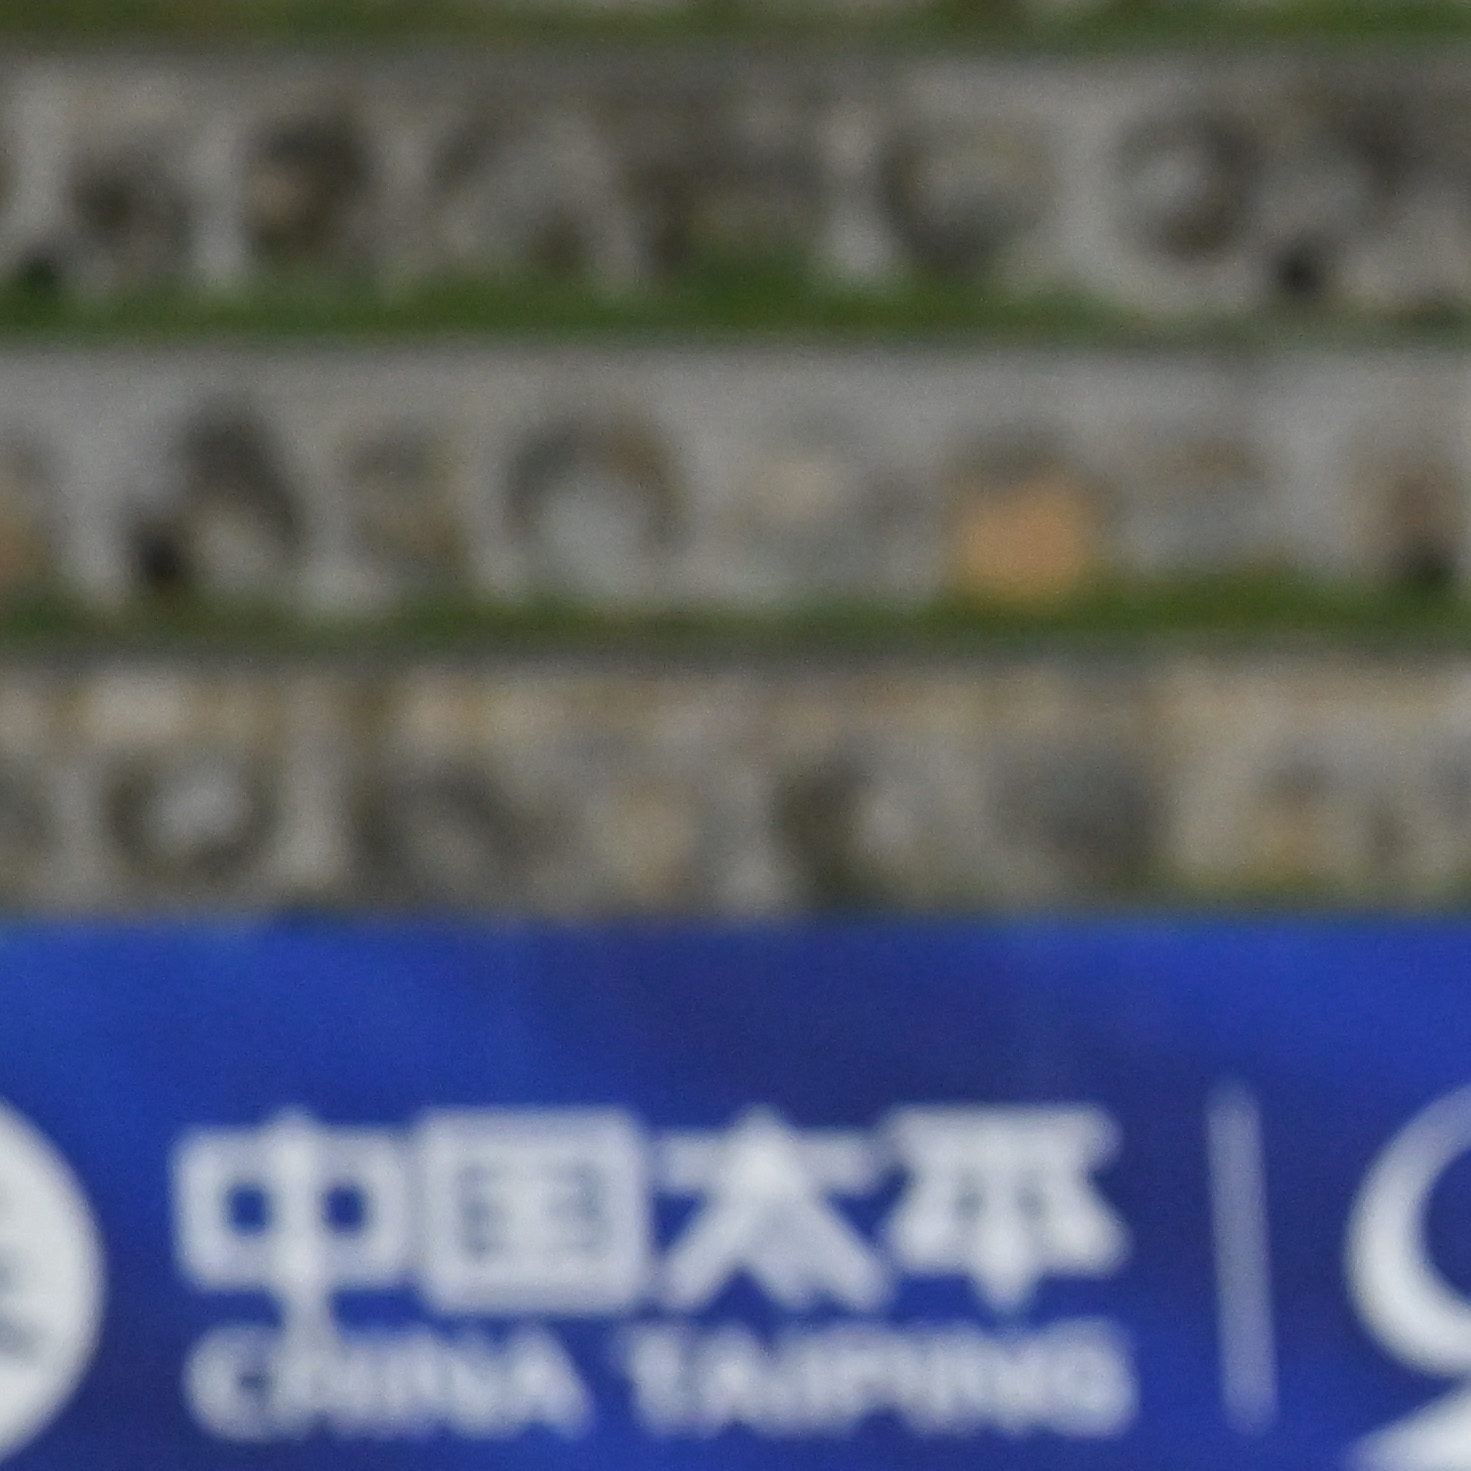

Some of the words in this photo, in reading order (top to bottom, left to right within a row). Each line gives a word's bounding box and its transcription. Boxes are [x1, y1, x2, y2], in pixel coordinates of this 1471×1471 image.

[172, 1105, 1130, 1335] 中国太平
[186, 1322, 594, 1440] CHINA
[620, 1318, 1138, 1438] TAIPING
